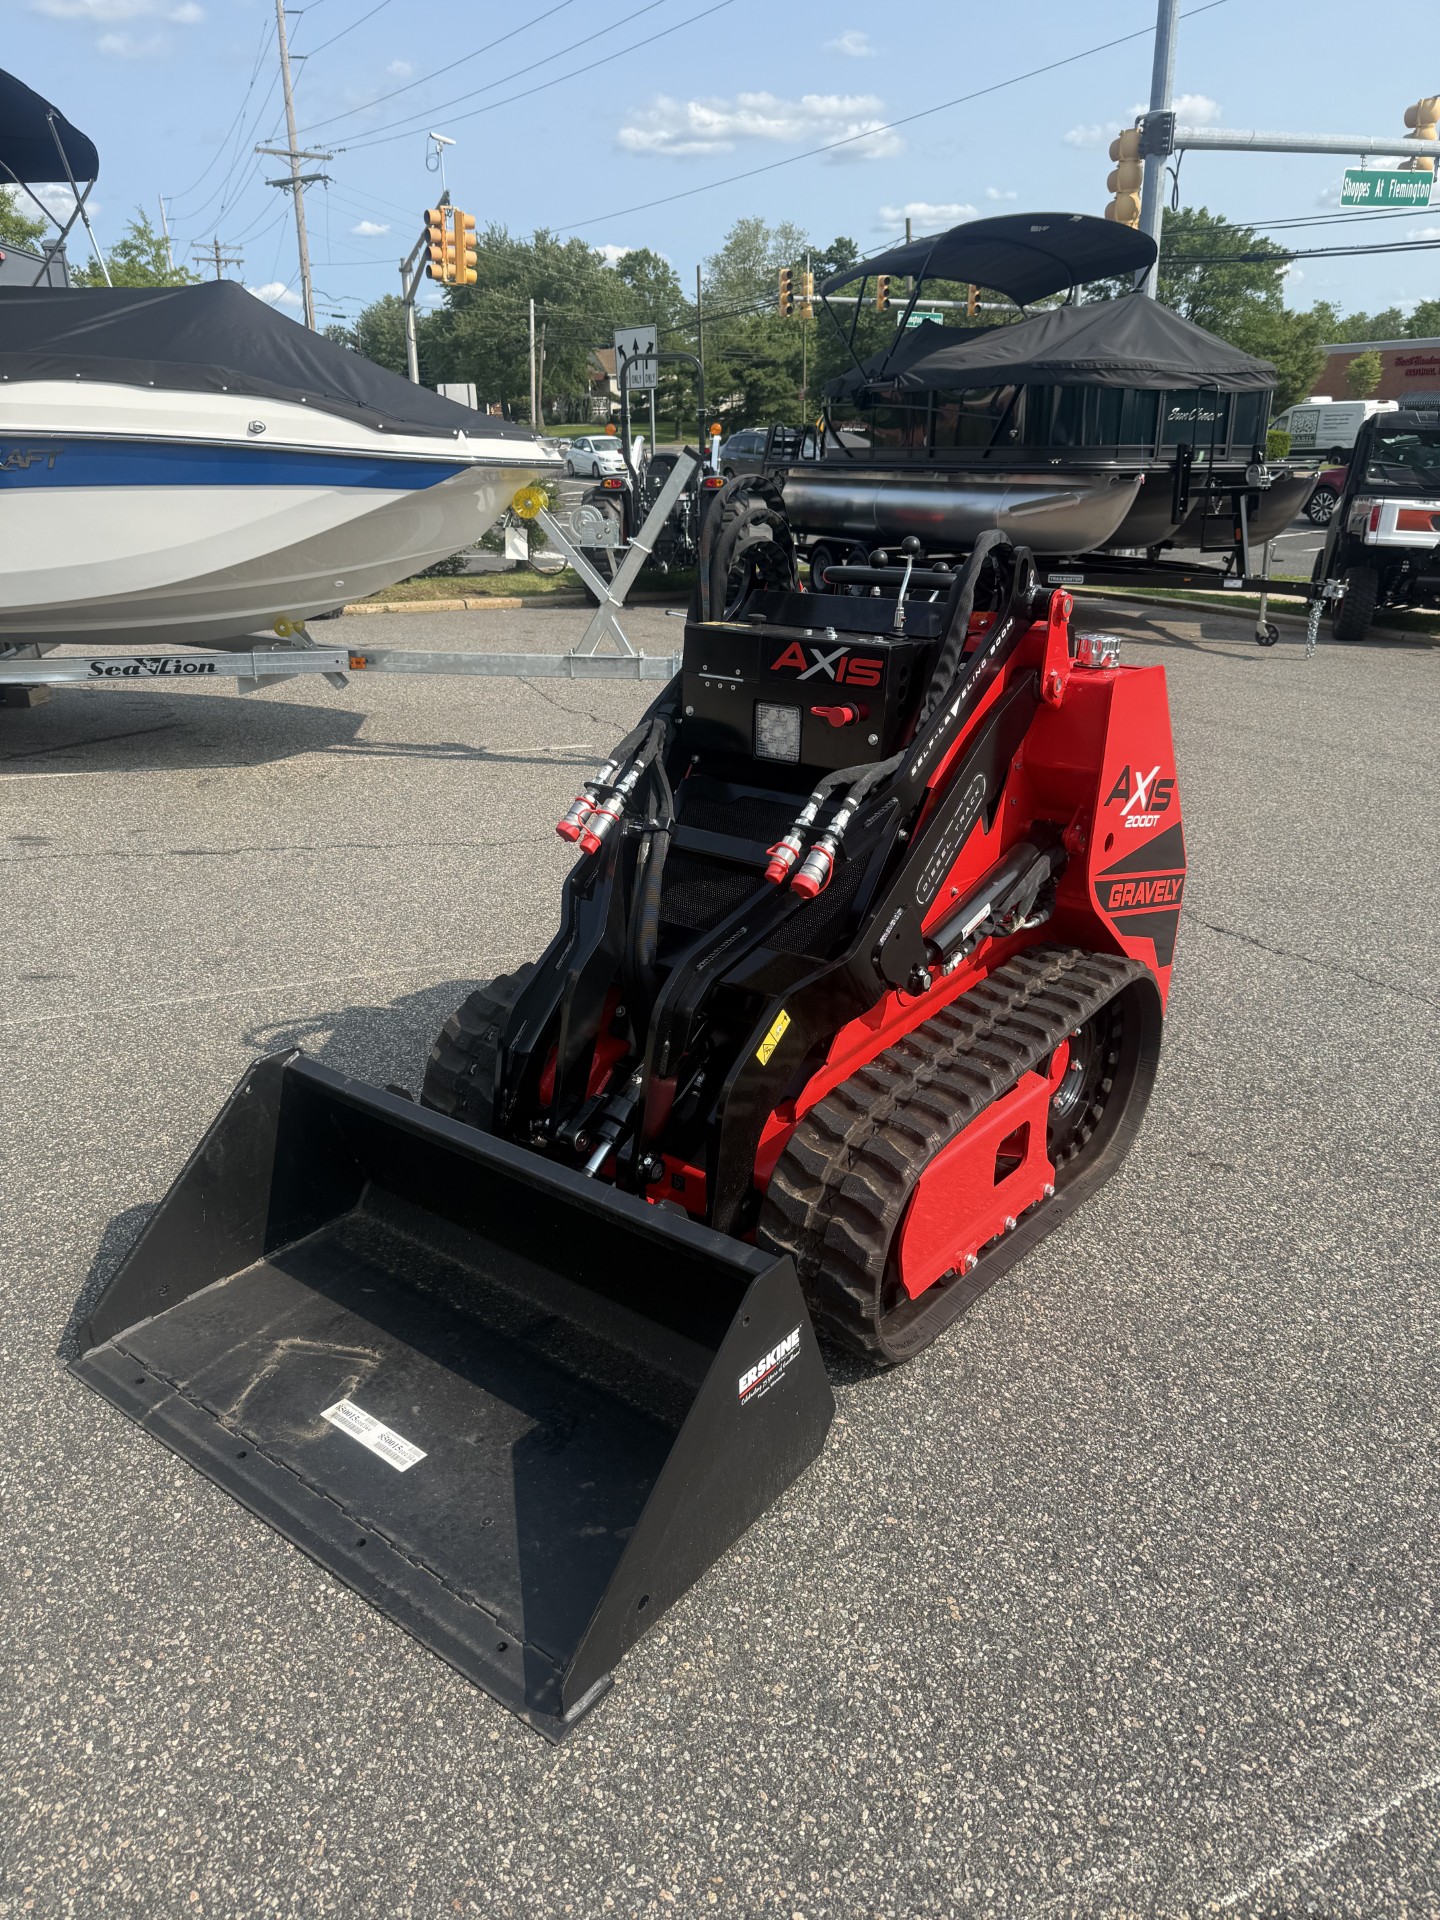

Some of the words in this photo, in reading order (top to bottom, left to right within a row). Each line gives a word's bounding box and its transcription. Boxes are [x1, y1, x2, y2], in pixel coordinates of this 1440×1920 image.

[1343, 177, 1371, 203] Shoppes
[1374, 179, 1385, 198] At
[1388, 179, 1430, 204] Flemington
[631, 374, 642, 384] ONLY
[645, 373, 655, 383] ONLY
[990, 618, 1014, 656] BOOM
[87, 661, 141, 676] Sea
[158, 659, 218, 675] Lion
[770, 641, 884, 687] AXIS
[1103, 764, 1175, 816] AXIS
[922, 841, 952, 892] DIESEL
[954, 788, 980, 832] TRACK
[1108, 878, 1182, 909] GRAVELY
[738, 1326, 800, 1395] ERSKINE
